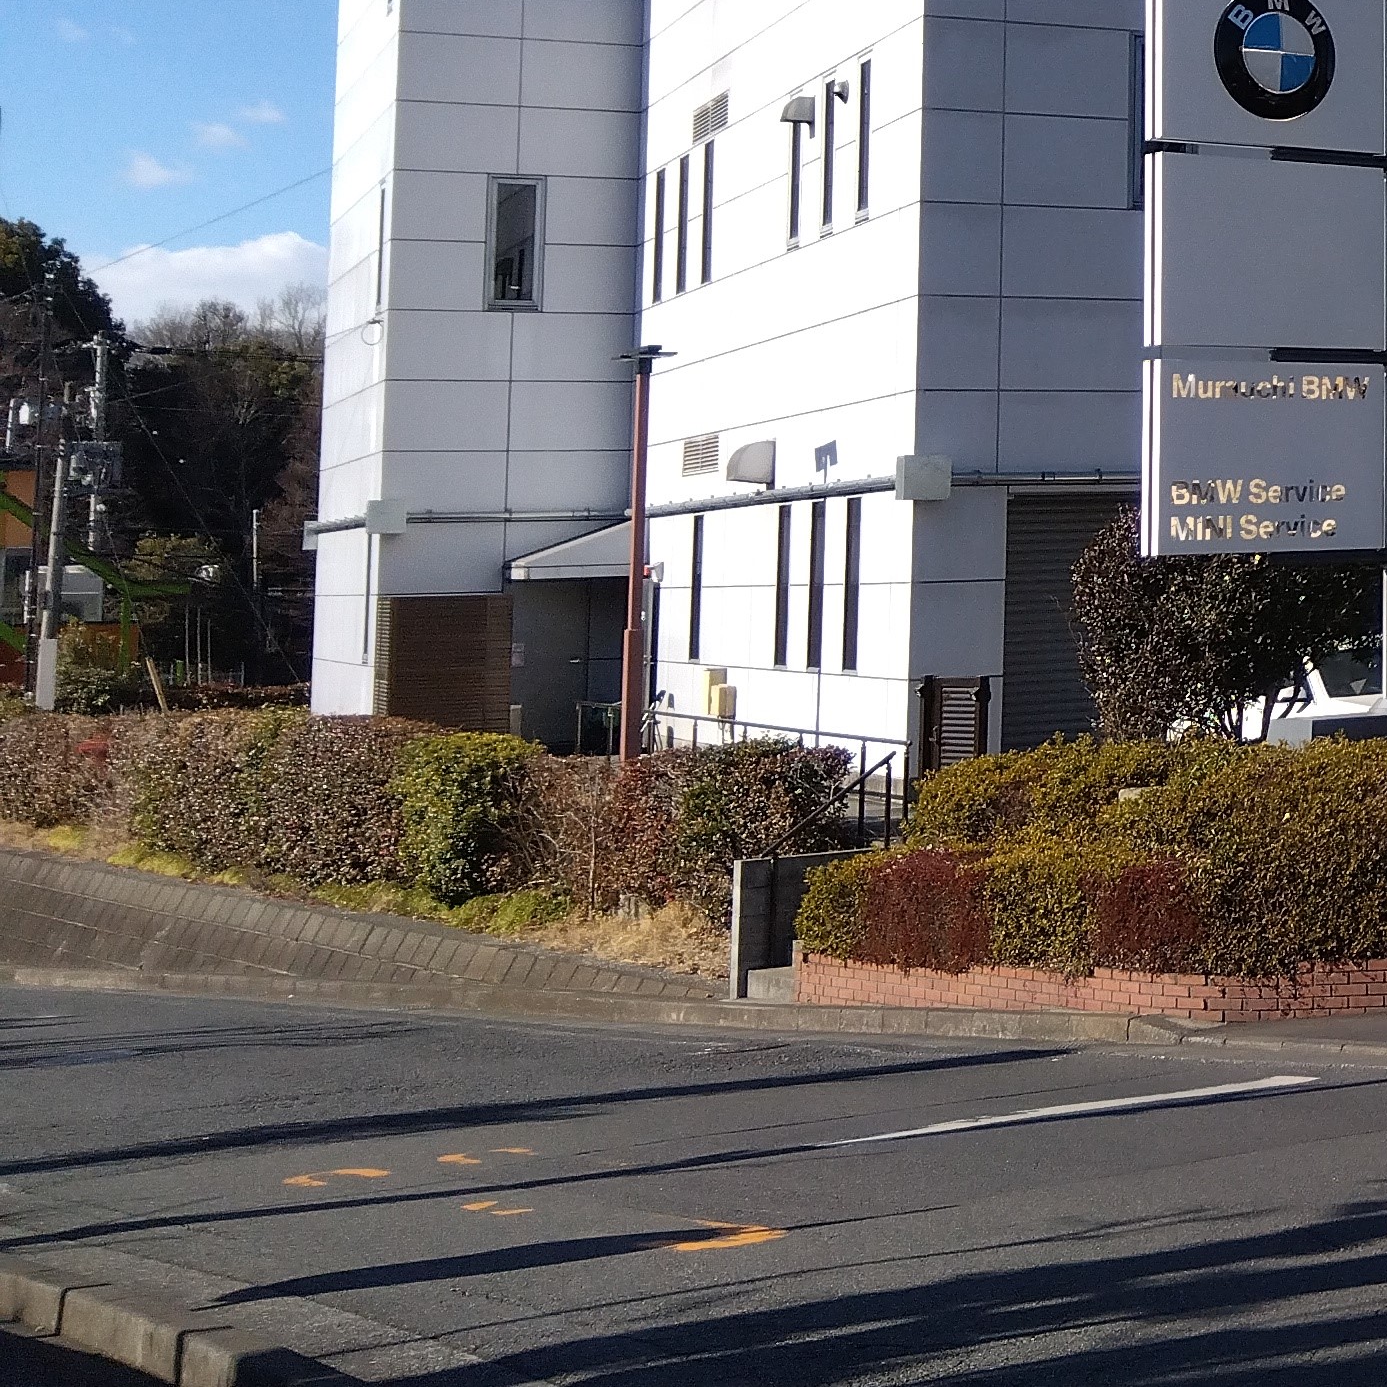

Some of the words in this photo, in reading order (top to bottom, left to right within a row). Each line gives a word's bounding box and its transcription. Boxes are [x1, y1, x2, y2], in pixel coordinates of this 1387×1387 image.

[1302, 375, 1370, 400] BMW
[1171, 479, 1243, 504] BMW
[1249, 478, 1346, 504] Service
[1170, 515, 1232, 541] MINI
[1239, 514, 1337, 540] Service
